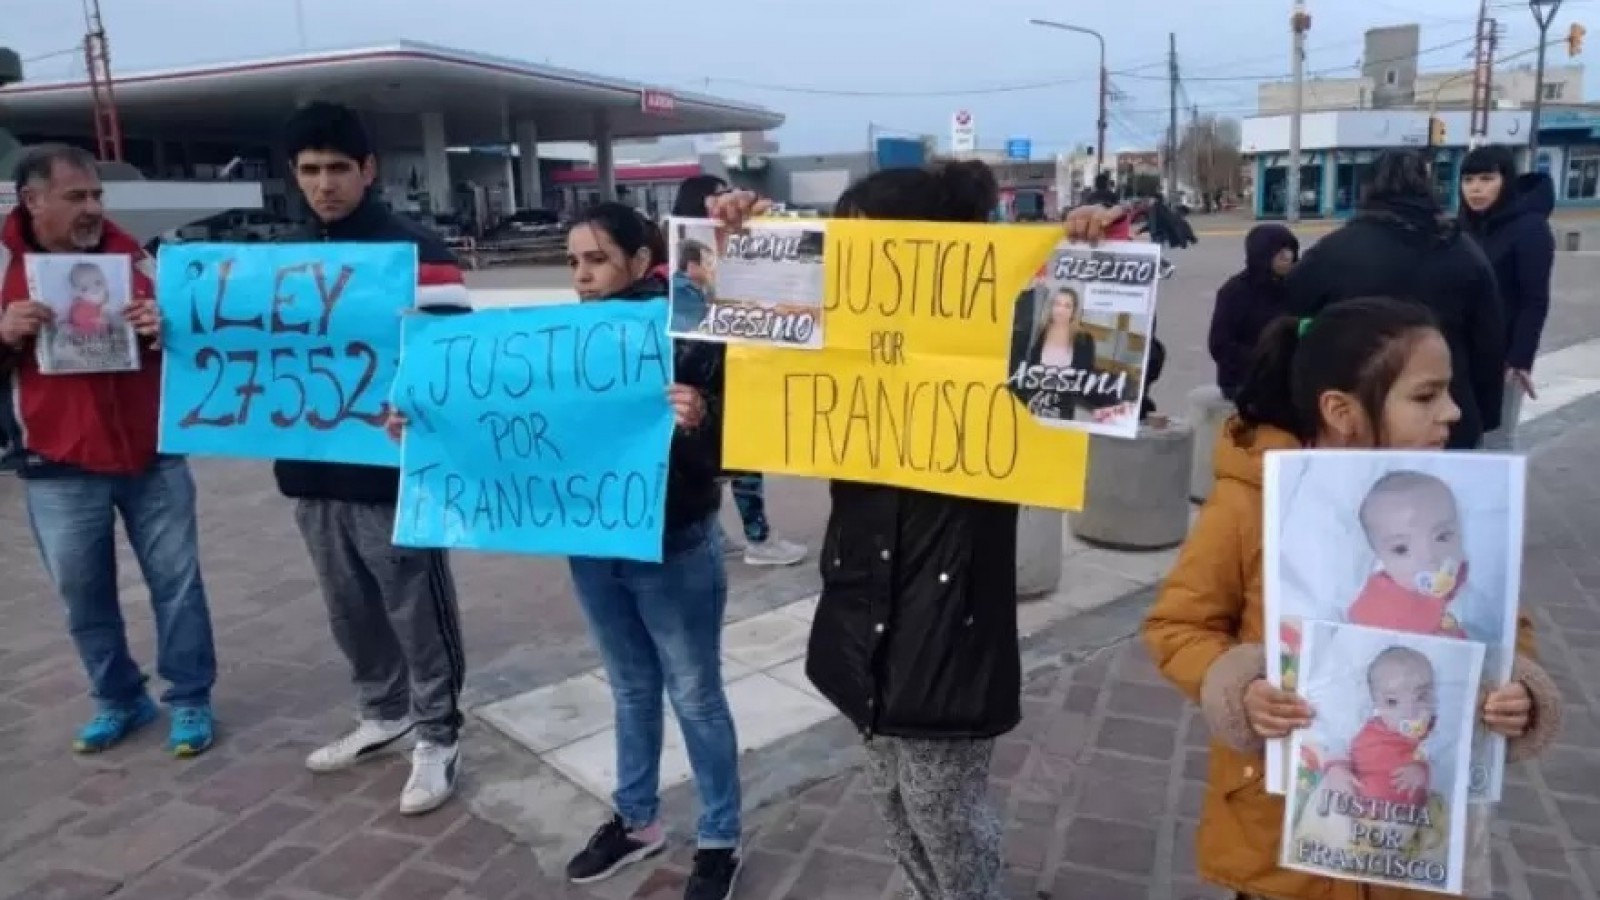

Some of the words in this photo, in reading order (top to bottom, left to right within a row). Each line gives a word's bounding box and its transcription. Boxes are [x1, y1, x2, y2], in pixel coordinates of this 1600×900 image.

[824, 239, 998, 325] JUSTICIA
[698, 303, 815, 344] ASESINO
[869, 330, 906, 367] POR
[1008, 360, 1128, 400] ASESINA
[478, 410, 564, 462] POR
[784, 374, 1018, 480] FRANCISCO
[407, 461, 666, 533] FRANCISCO!
[1316, 789, 1432, 826] JUSTICIA
[1352, 823, 1402, 850] POR
[1299, 839, 1447, 882] FRANCISCO
